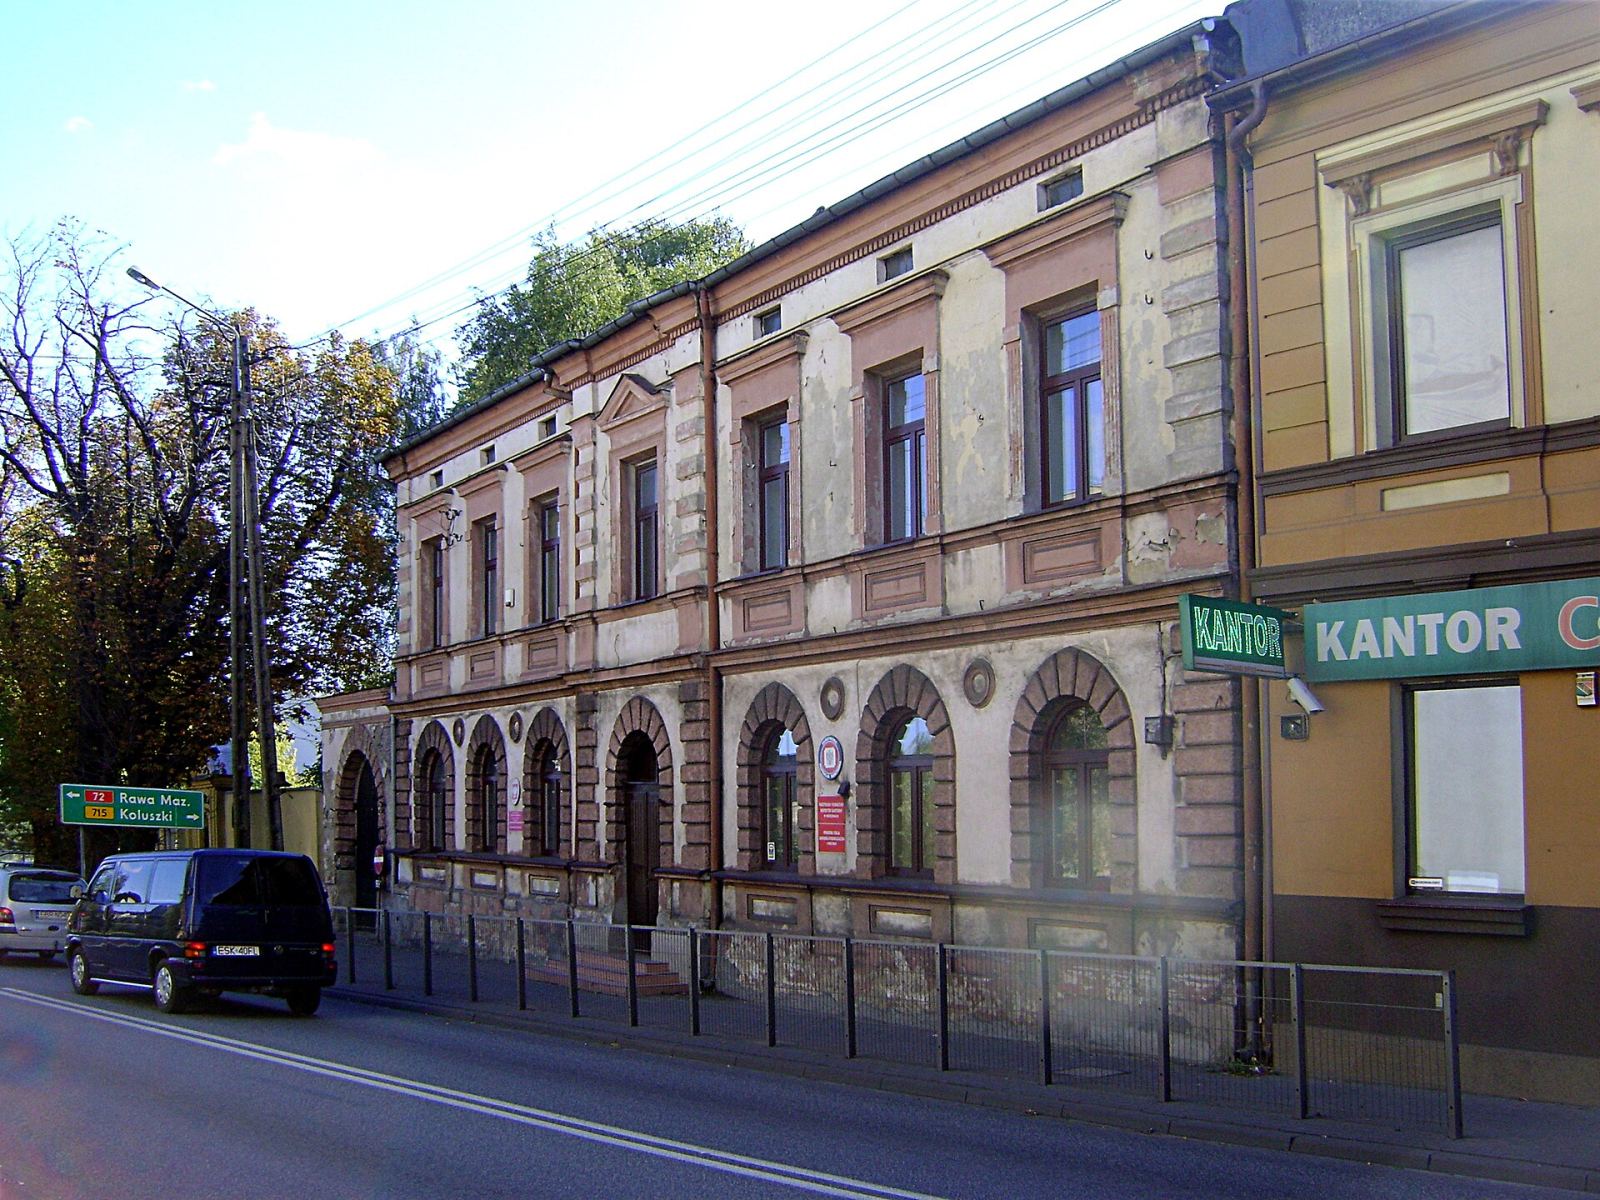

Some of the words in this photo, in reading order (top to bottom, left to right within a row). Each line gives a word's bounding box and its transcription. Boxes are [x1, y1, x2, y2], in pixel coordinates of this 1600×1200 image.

[1194, 606, 1282, 658] KANTOR
[1316, 607, 1521, 662] KANTOR
[92, 792, 105, 802] 72
[120, 792, 155, 805] Rawa
[161, 794, 191, 807] Maz.
[91, 808, 107, 817] 715
[119, 809, 173, 822] Koluszki
